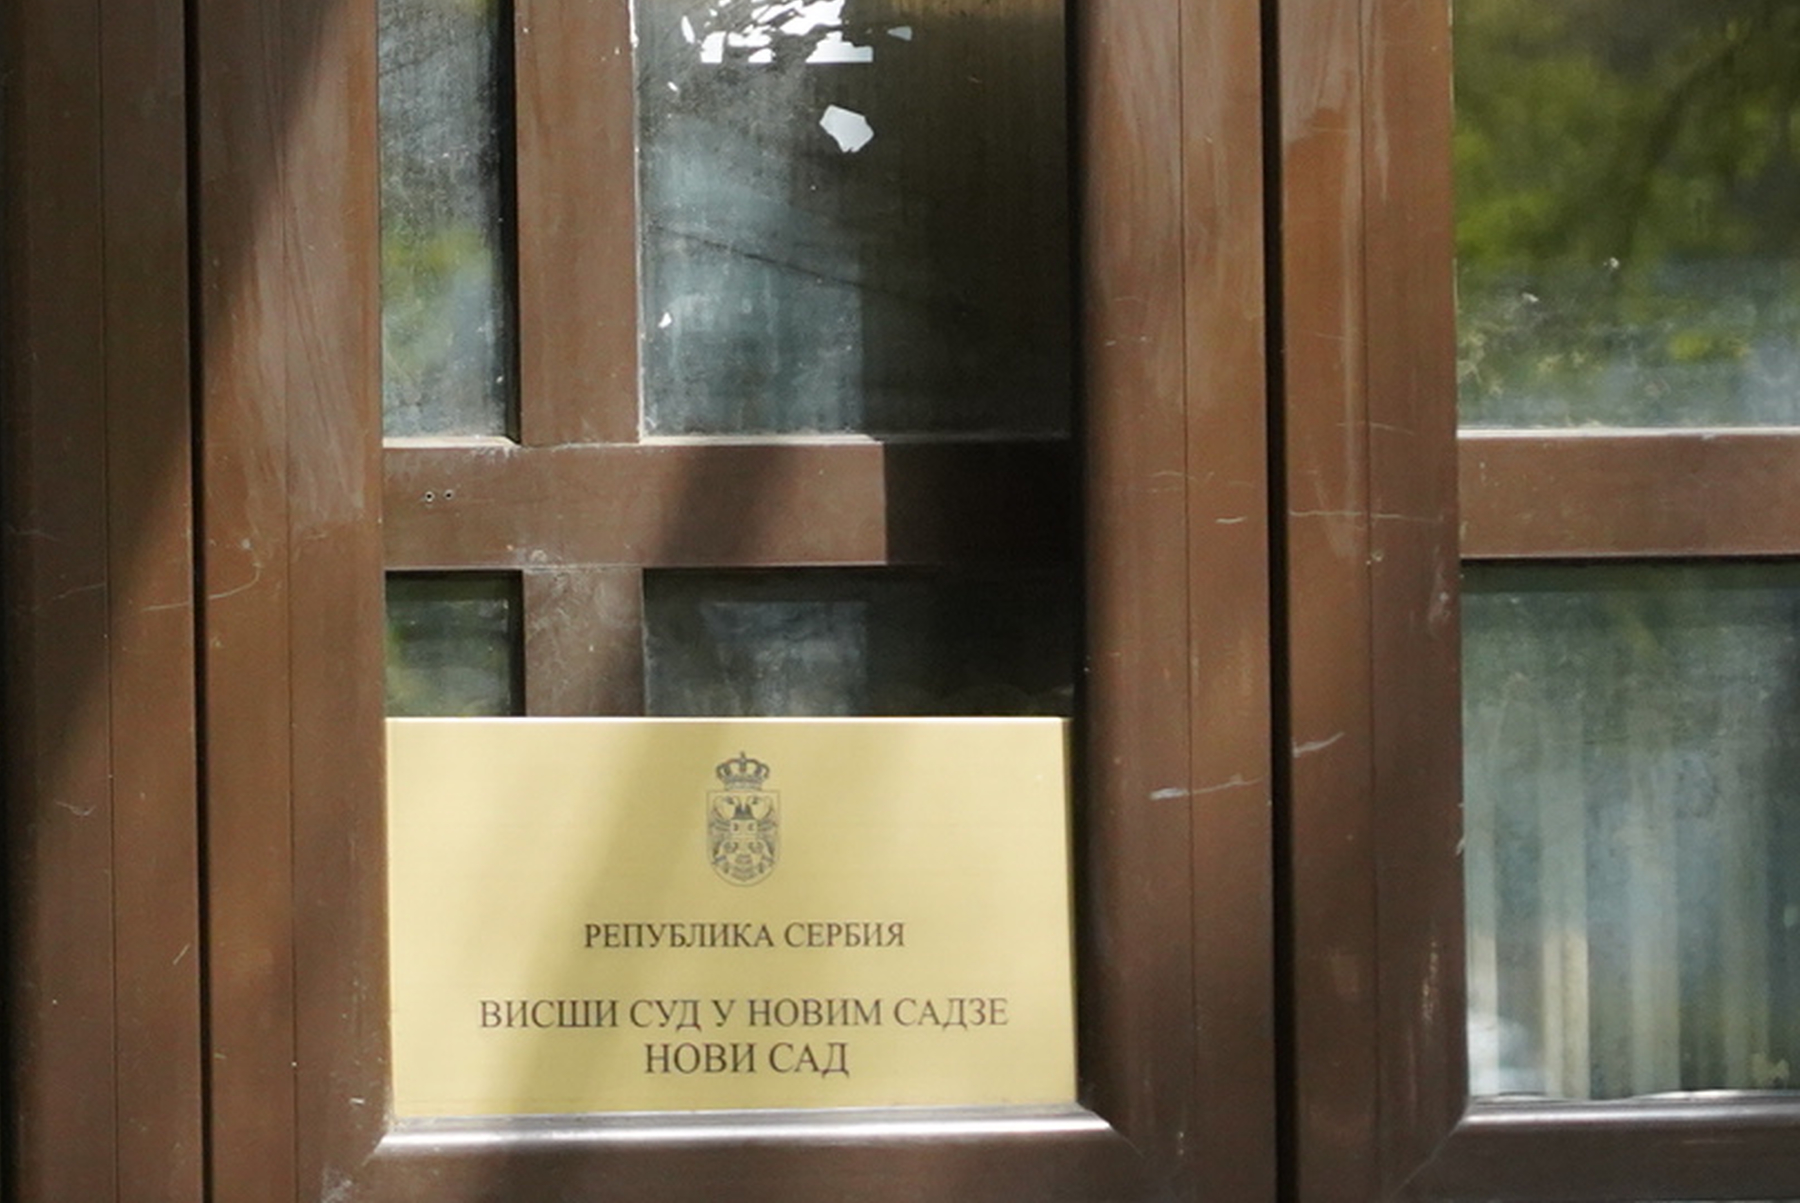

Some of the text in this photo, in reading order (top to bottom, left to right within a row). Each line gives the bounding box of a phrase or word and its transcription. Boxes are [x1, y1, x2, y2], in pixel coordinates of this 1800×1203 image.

[583, 921, 906, 949] РЕПУБЛИКА СЕРБИЯ
[479, 997, 1010, 1033] ВИСШИ СУД У НОВИМ САДЗЕ
[644, 1041, 851, 1079] НОВИ САД
